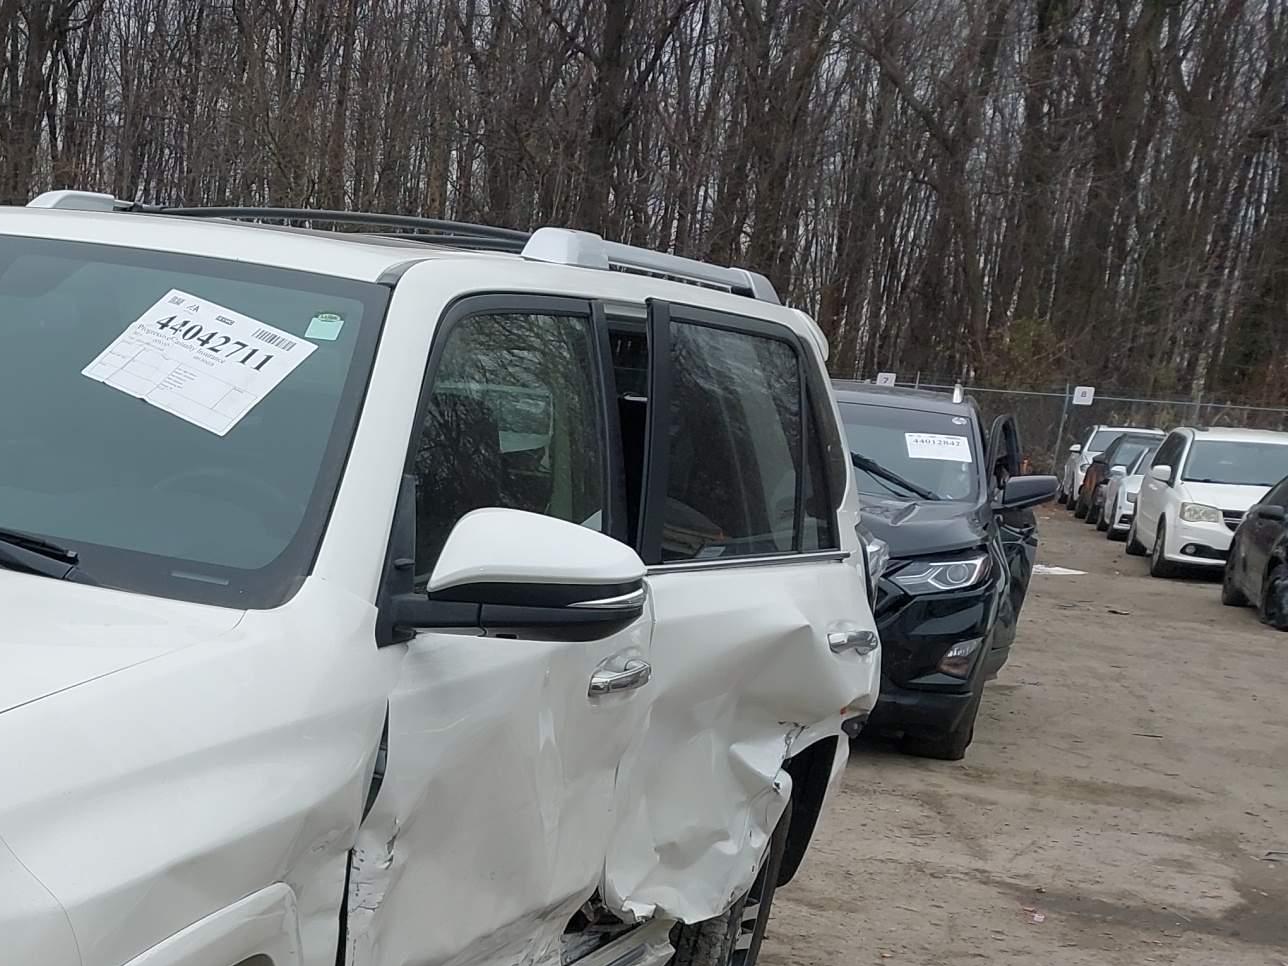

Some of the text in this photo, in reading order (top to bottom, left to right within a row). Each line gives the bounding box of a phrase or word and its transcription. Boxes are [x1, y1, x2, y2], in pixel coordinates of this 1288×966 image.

[156, 315, 275, 371] 44042711
[170, 336, 195, 352] Casualty
[196, 347, 226, 364] Insurance
